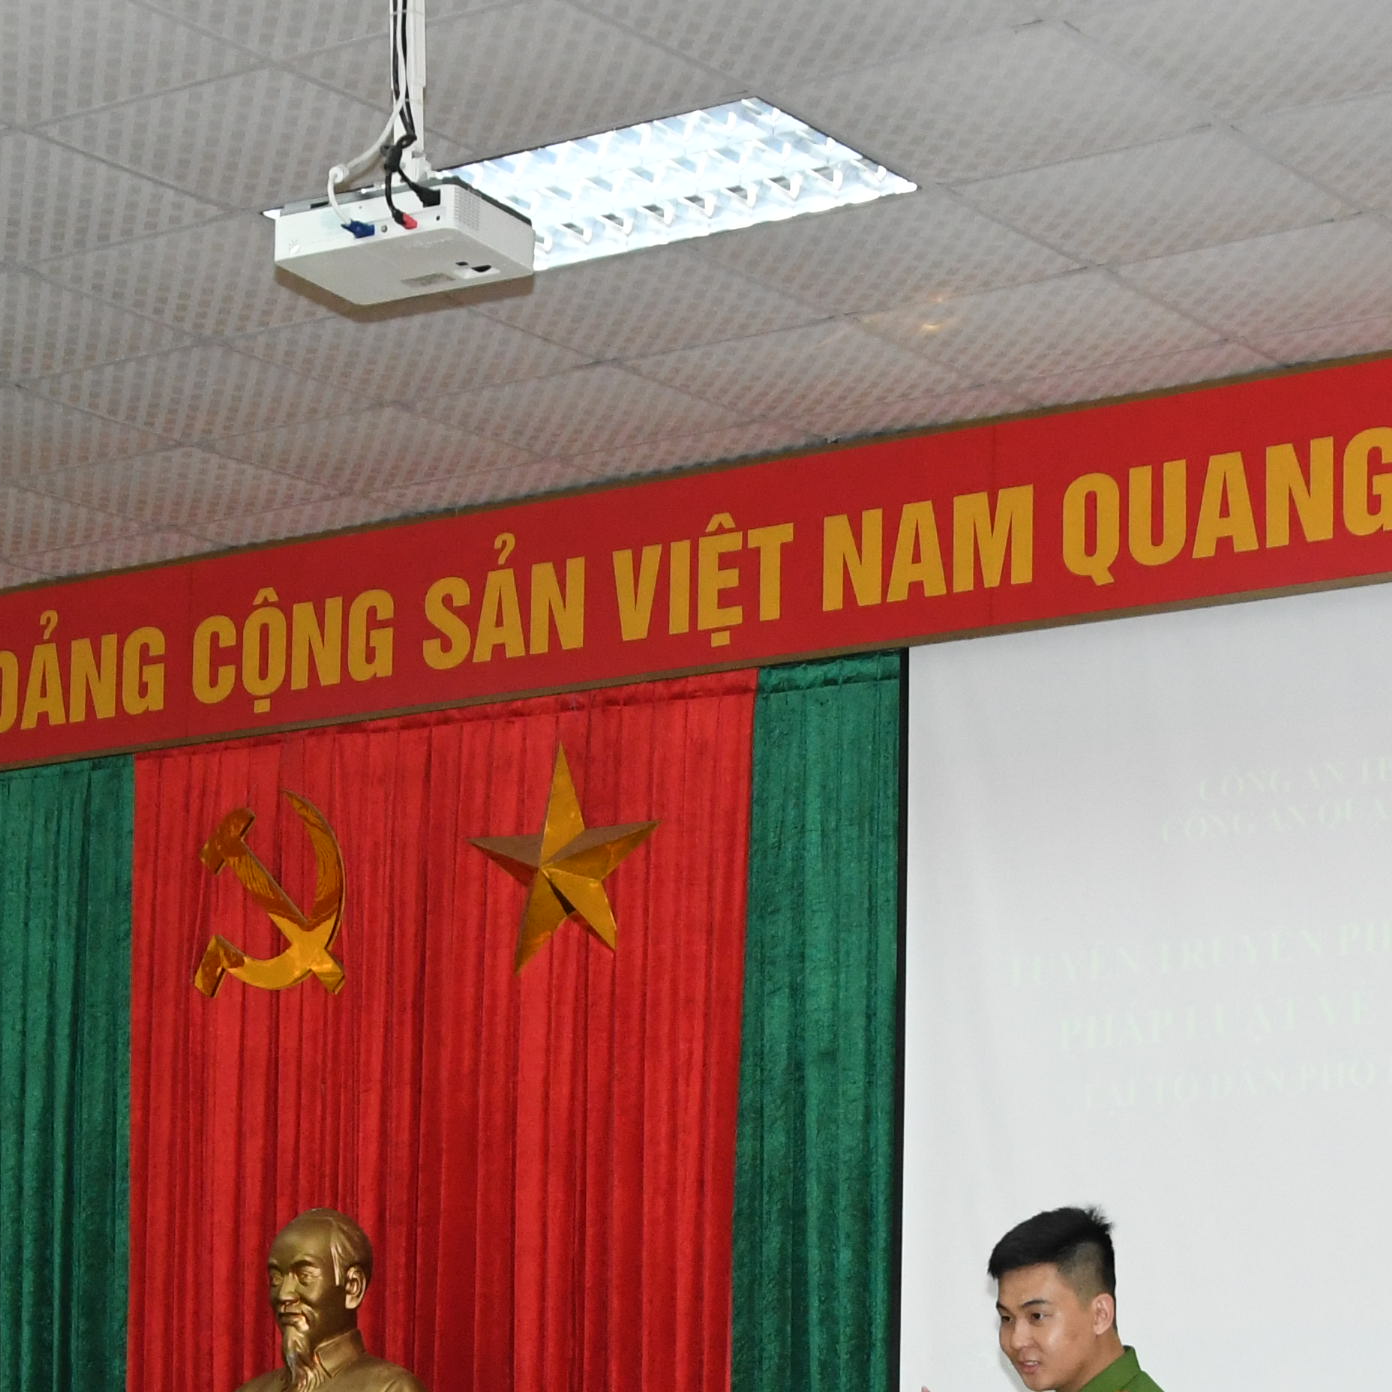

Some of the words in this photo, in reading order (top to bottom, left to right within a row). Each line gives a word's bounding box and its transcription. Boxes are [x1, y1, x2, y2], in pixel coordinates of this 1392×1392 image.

[192, 587, 394, 713] CỘNG
[423, 533, 585, 670] SẢN
[614, 513, 794, 647] VIỆT
[823, 485, 1034, 611] NAM
